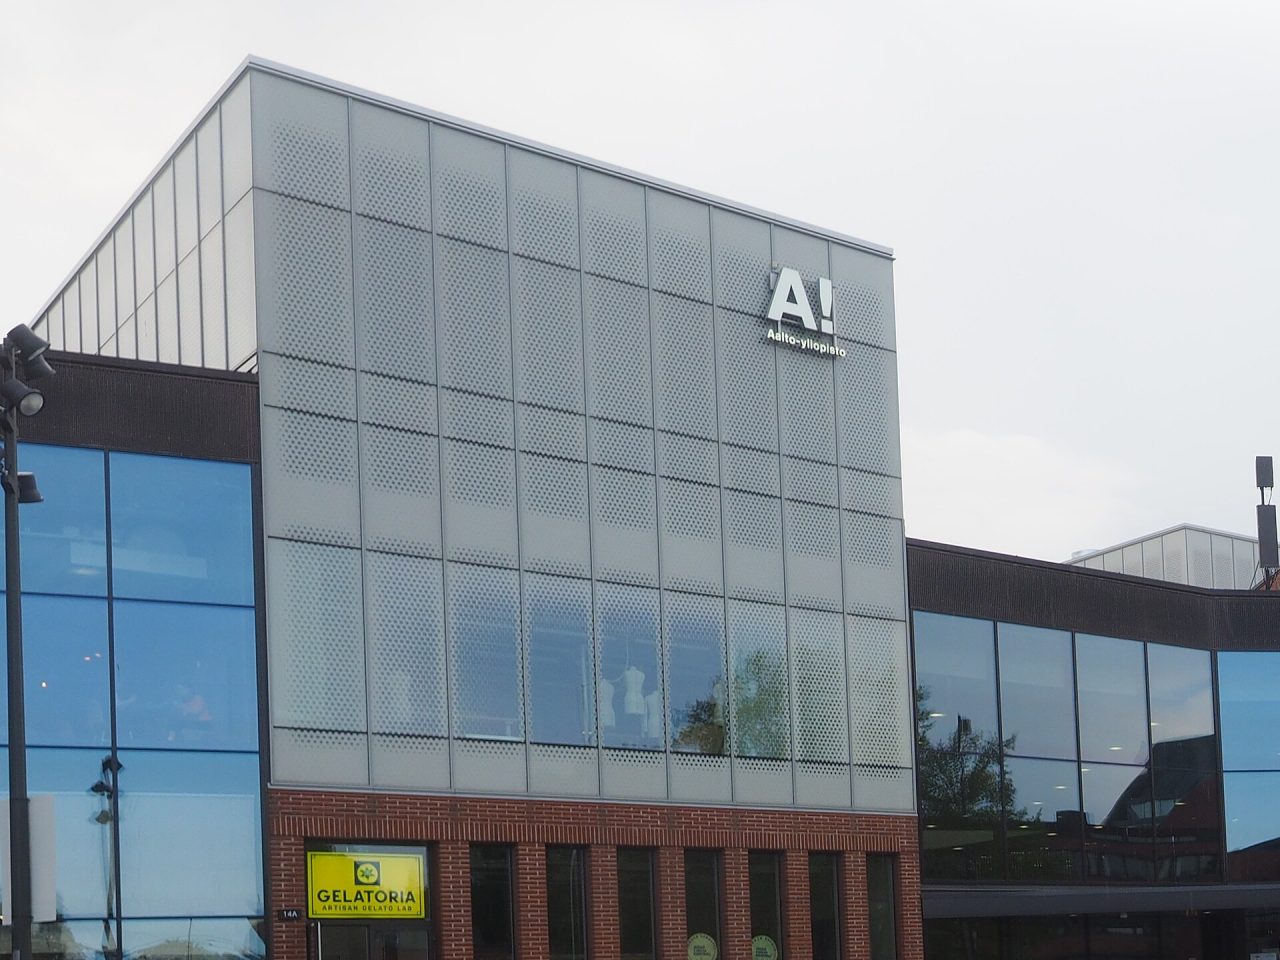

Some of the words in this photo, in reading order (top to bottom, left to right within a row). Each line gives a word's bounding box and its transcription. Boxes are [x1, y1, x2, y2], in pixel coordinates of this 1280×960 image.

[767, 267, 834, 335] A!
[767, 328, 847, 357] Aalto-yliopisto
[317, 889, 416, 903] GELATORIA
[283, 910, 298, 918] 14A
